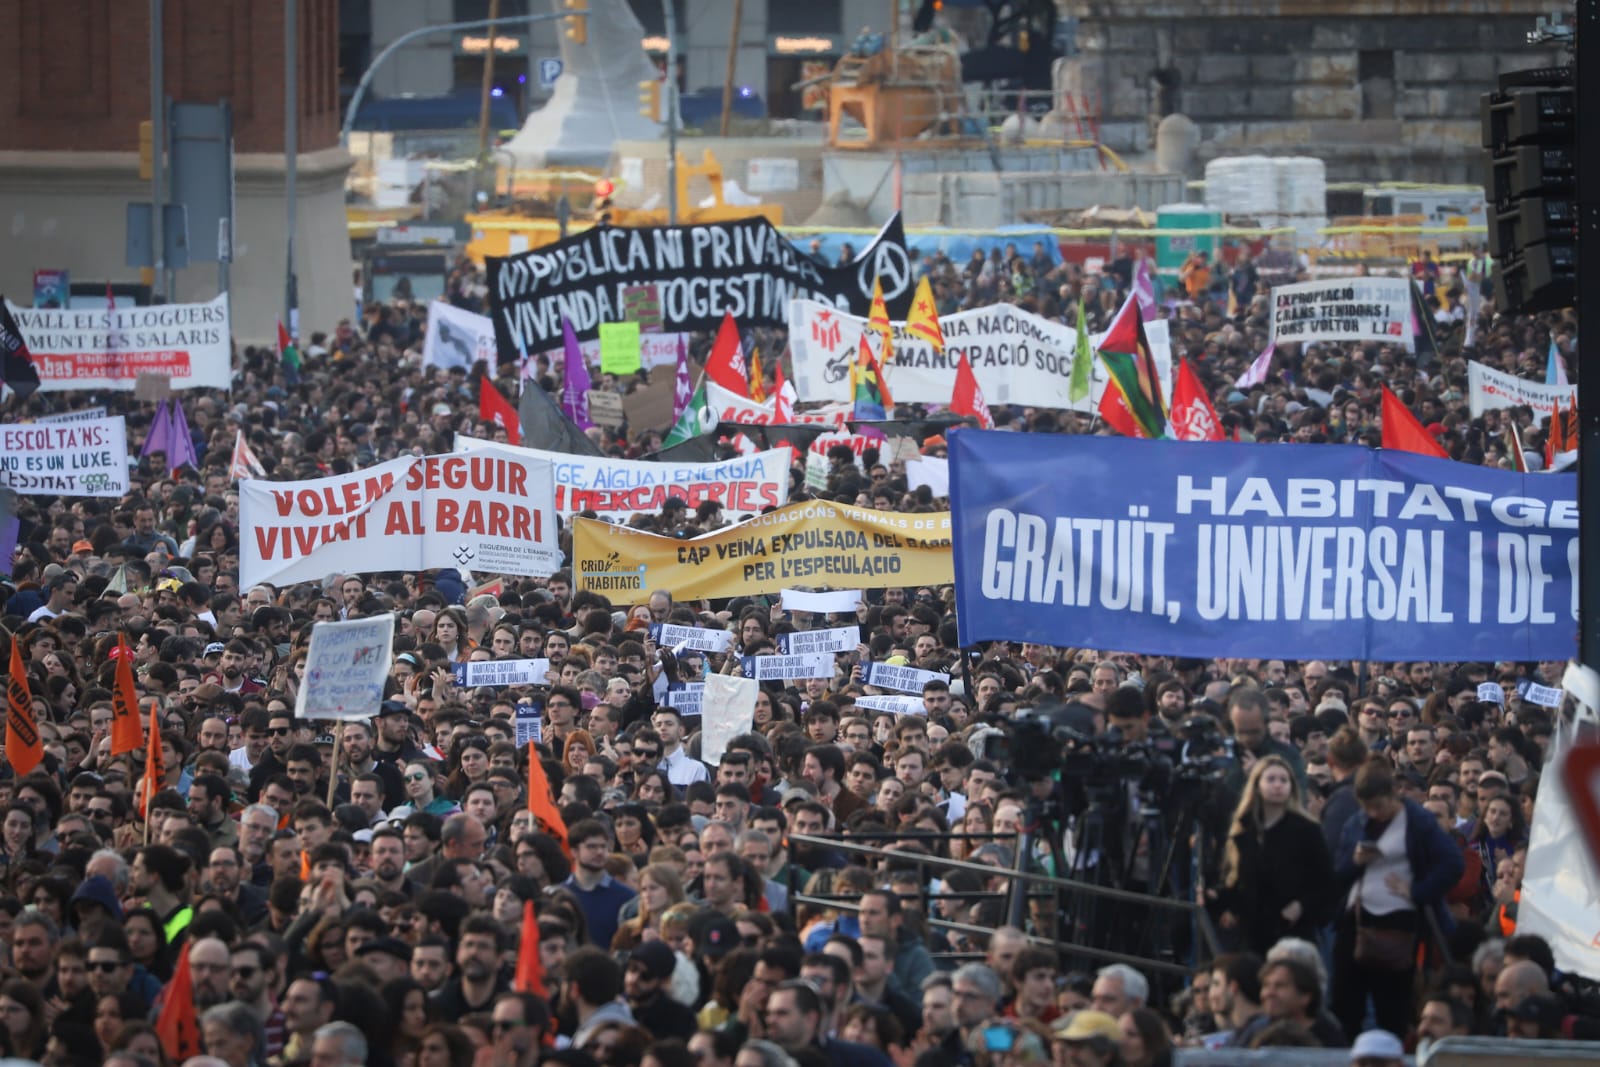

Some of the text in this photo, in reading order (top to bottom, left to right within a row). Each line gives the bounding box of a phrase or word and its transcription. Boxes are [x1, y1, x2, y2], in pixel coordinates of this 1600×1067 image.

[498, 258, 529, 300] NI
[653, 228, 685, 271] NI
[691, 223, 824, 286] PRIVADA
[75, 314, 112, 330] ELS
[117, 306, 225, 330] LLOGUERS
[503, 284, 615, 350] VIVENDA
[1310, 318, 1360, 334] VOLTOR
[136, 328, 220, 348] SALARIS
[1035, 349, 1103, 382] SOCL
[47, 455, 64, 471] UN
[673, 457, 767, 482] ENERGIA
[270, 457, 528, 517] VOLEM SEGUIR
[1175, 474, 1580, 529] HABITATGE
[384, 500, 426, 536] AL
[436, 498, 543, 543] BARRI
[914, 519, 937, 530] DE
[677, 546, 711, 566] CAP
[715, 535, 767, 560] VEÏNA
[771, 527, 869, 555] EXPULSADA
[873, 532, 903, 549] DEL
[743, 561, 776, 582] PER
[980, 504, 1181, 624] GRATUÏT,
[1196, 523, 1454, 624] UNIVERSAL
[1467, 530, 1483, 625] I
[1498, 533, 1556, 625] DE
